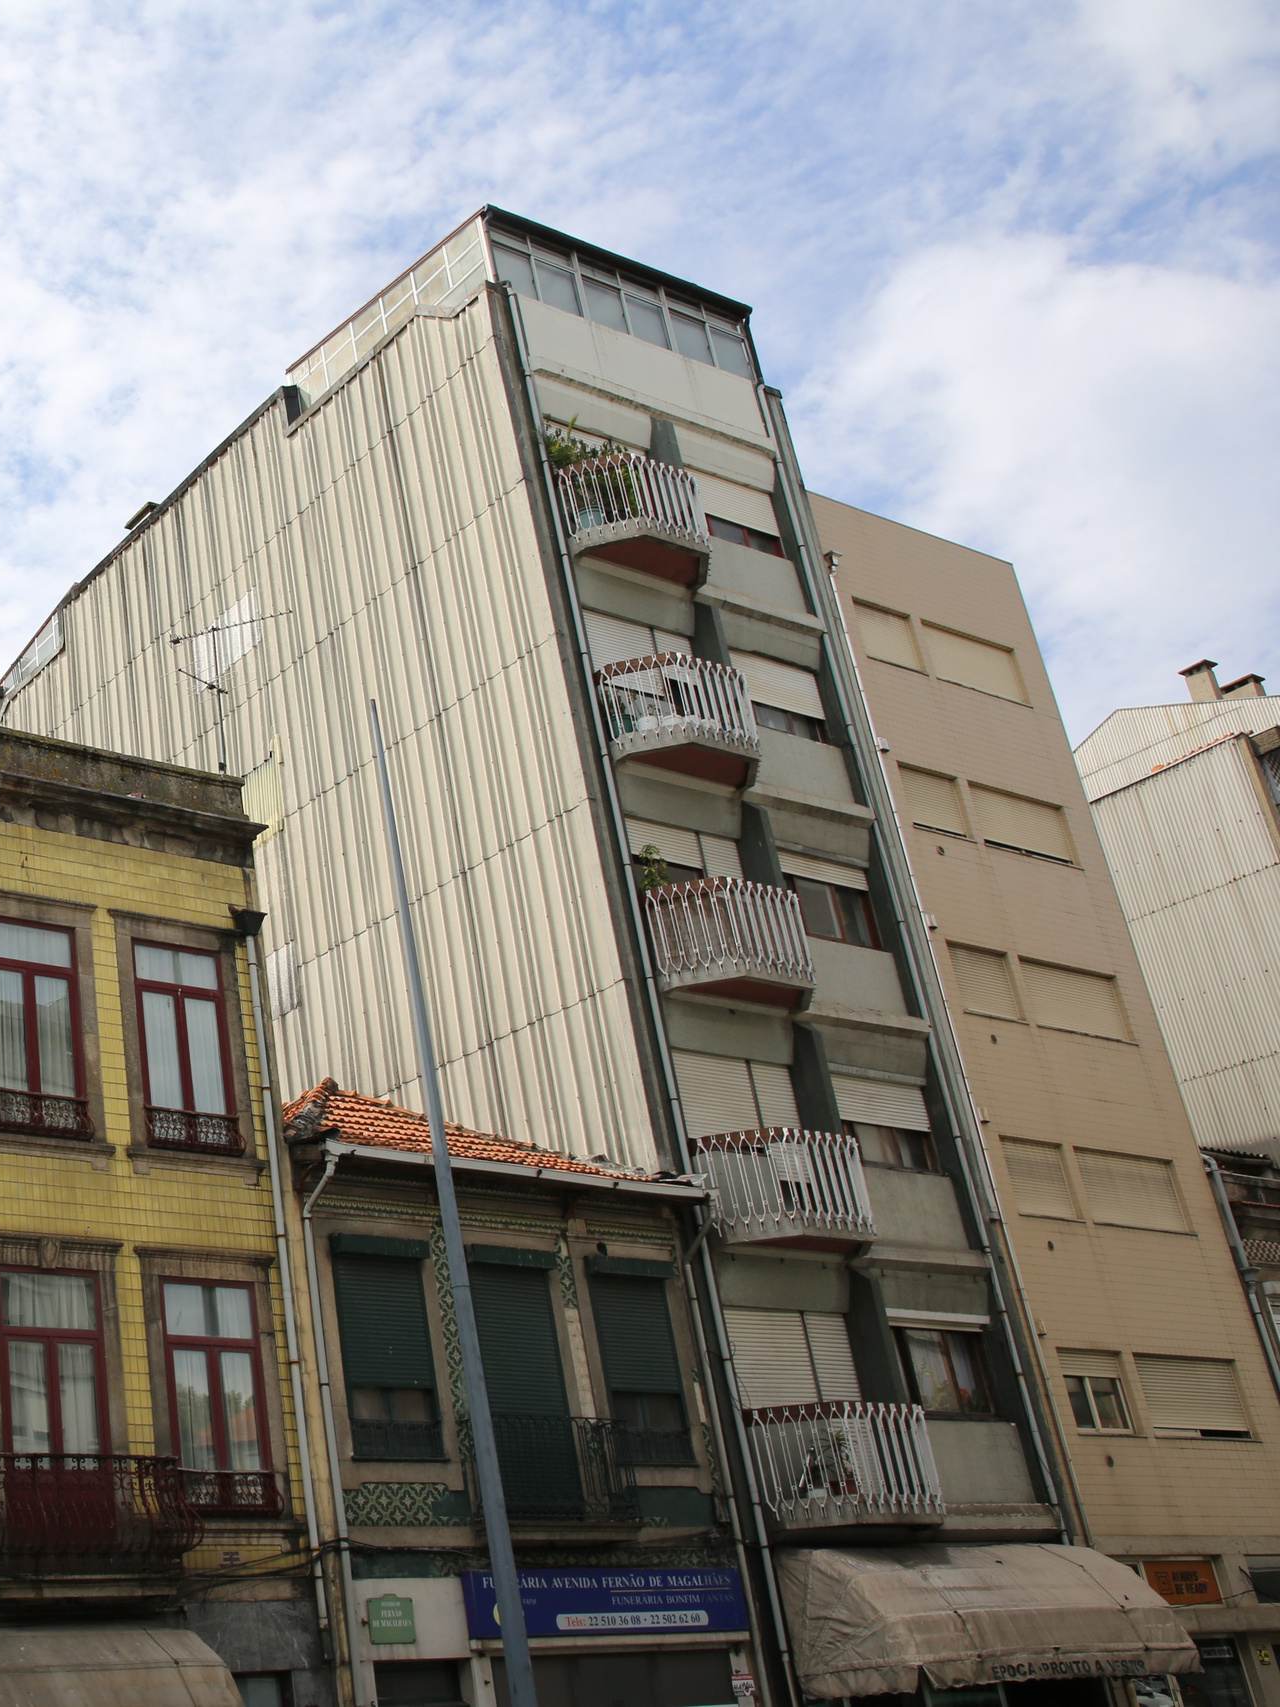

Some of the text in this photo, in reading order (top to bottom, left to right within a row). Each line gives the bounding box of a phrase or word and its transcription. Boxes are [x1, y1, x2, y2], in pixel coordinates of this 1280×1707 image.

[483, 1572, 731, 1588] FURÁRIA AVENIDA FERNÃO DE MAGALHÃES
[1172, 1571, 1199, 1581] ALWAYS
[1175, 1583, 1208, 1595] BE READY
[611, 1594, 663, 1606] FUNERÁRIA
[565, 1612, 701, 1627] Tels: 22 510 36 08 22 502 62 60
[991, 1662, 1037, 1680] ÉPOCA
[1041, 1660, 1091, 1676] PRONTO
[1094, 1660, 1105, 1672] A
